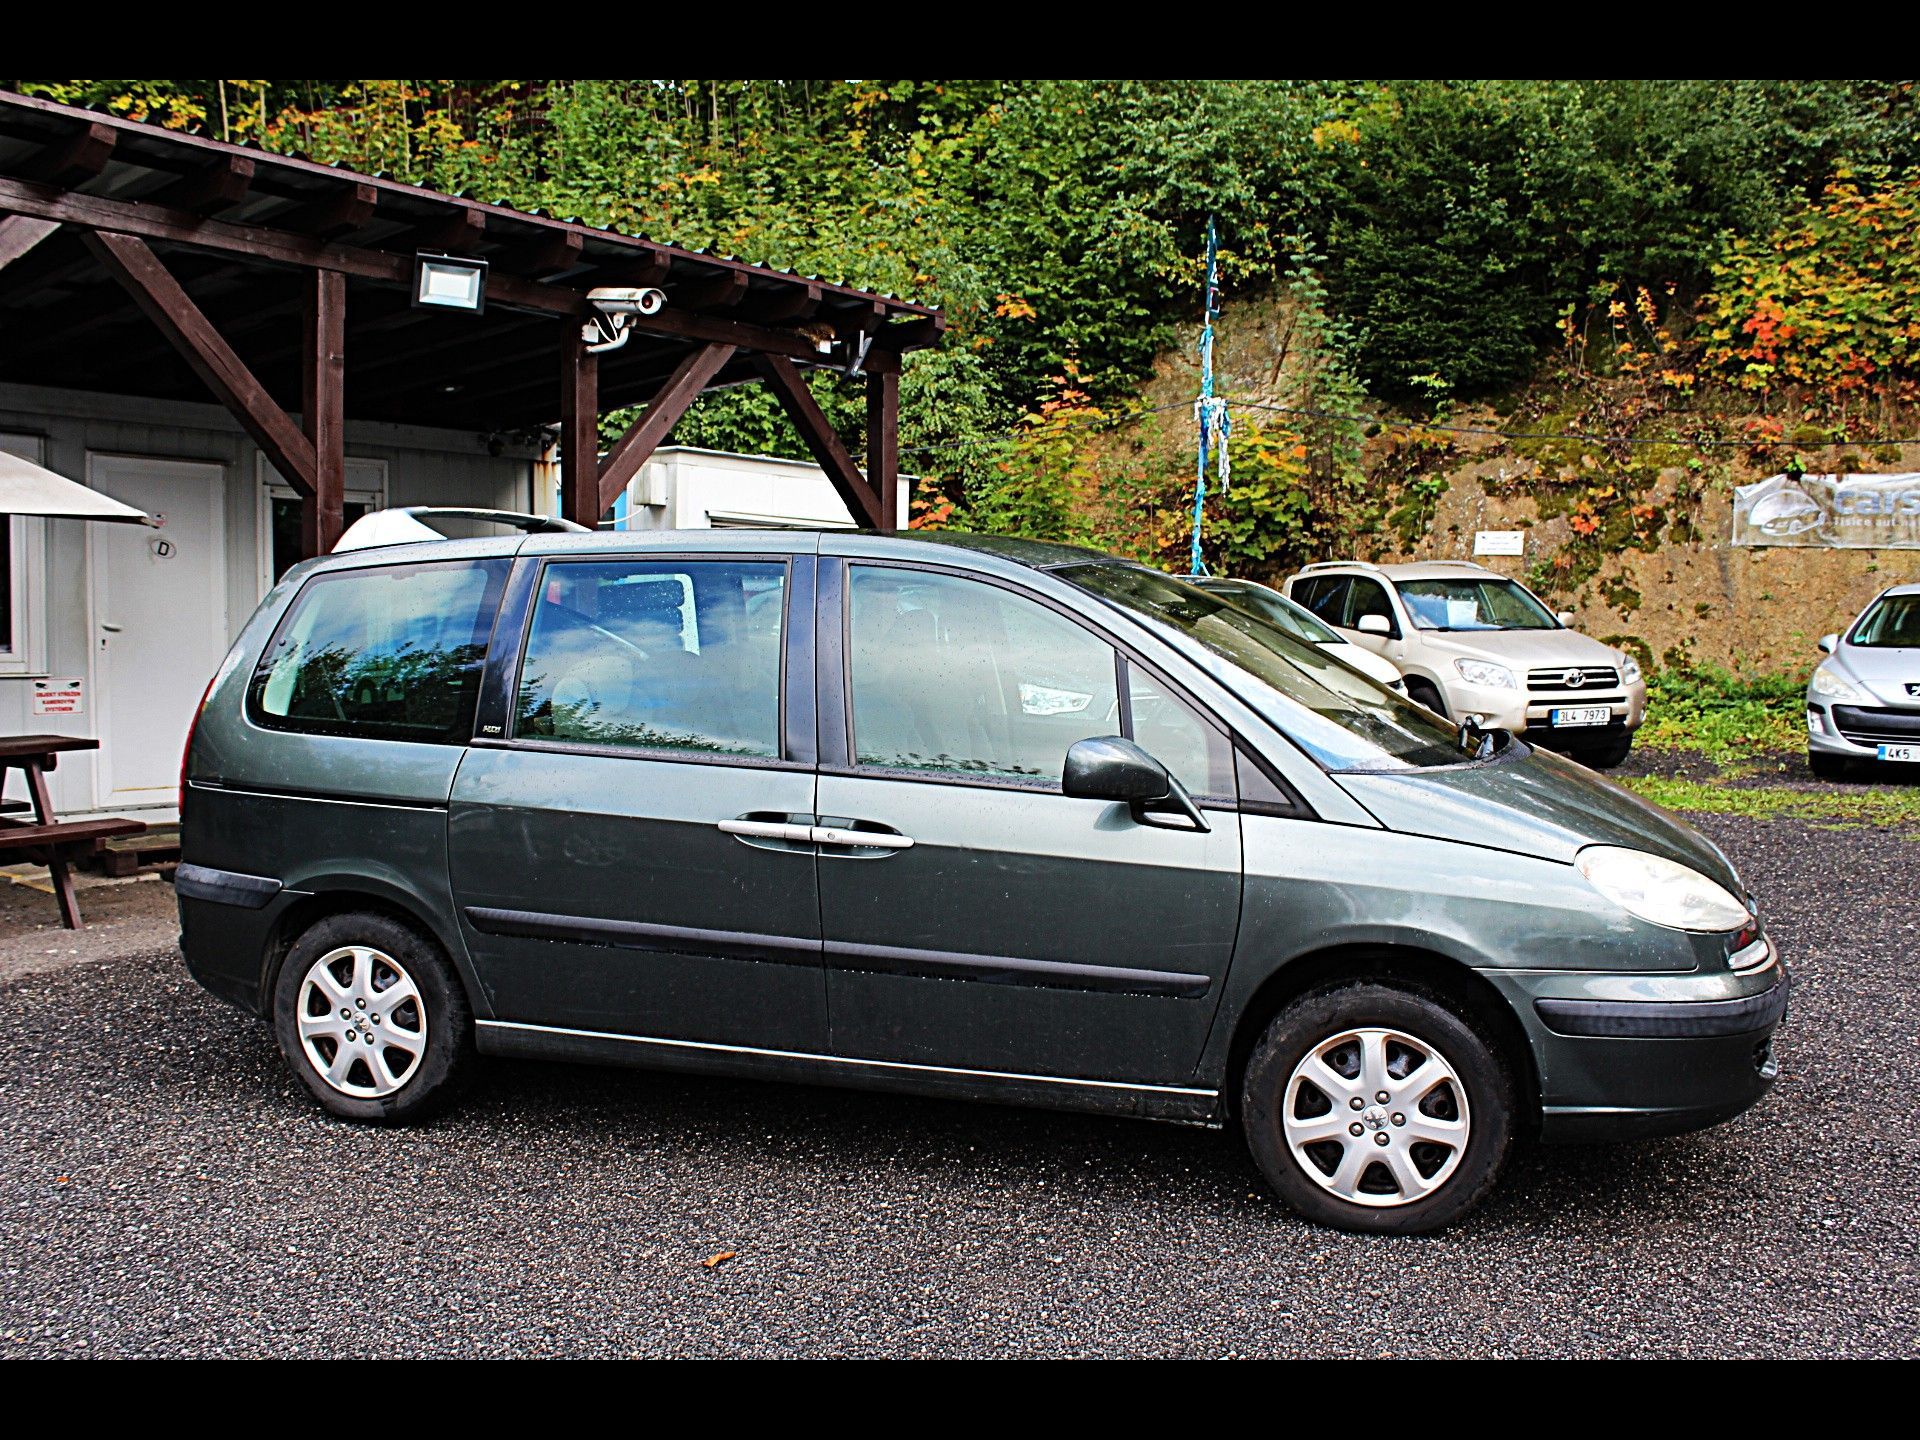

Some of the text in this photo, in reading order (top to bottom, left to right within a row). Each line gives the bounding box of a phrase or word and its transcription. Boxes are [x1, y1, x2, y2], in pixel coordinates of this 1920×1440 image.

[158, 541, 169, 556] D
[1560, 709, 1606, 721] 3L4 7973
[1888, 748, 1910, 760] 4K5
